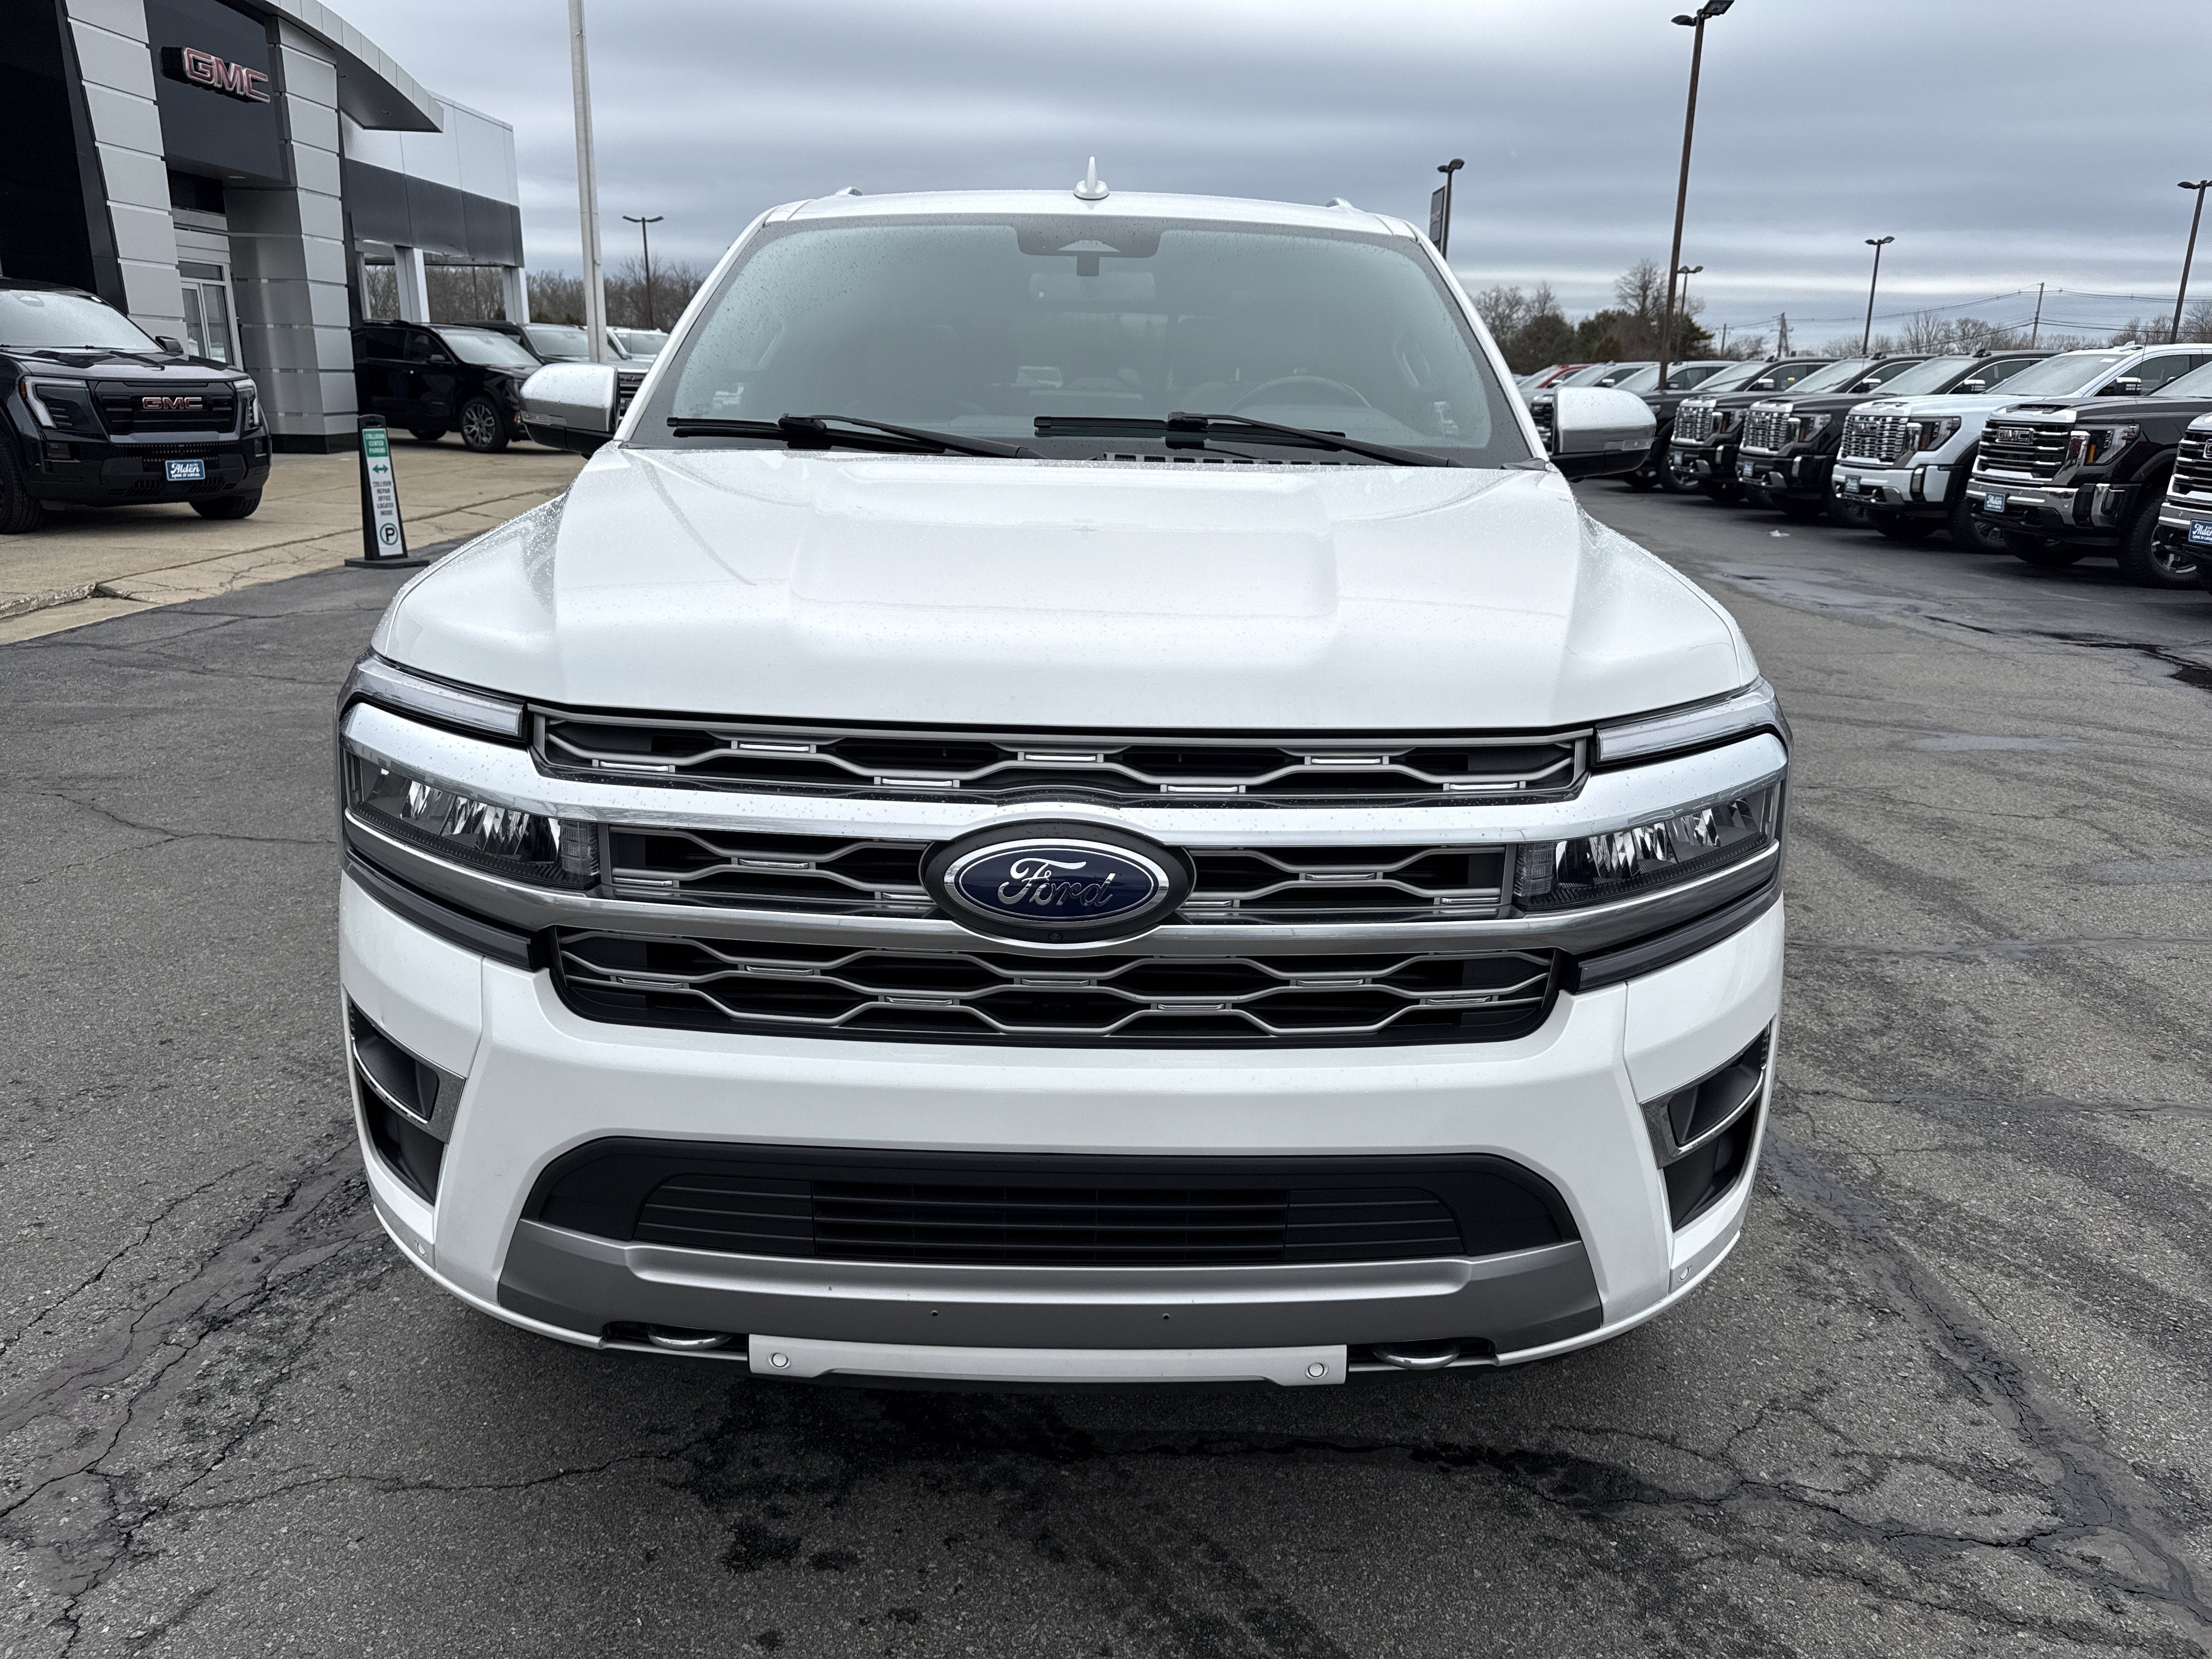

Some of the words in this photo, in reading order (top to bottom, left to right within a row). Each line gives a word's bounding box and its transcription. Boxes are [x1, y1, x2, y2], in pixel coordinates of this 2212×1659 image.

[183, 47, 270, 104] GMC
[142, 397, 203, 409] GMC
[1997, 429, 2030, 442] GMC
[170, 463, 201, 474] Alden
[385, 527, 395, 541] P
[997, 857, 1116, 907] Ford
